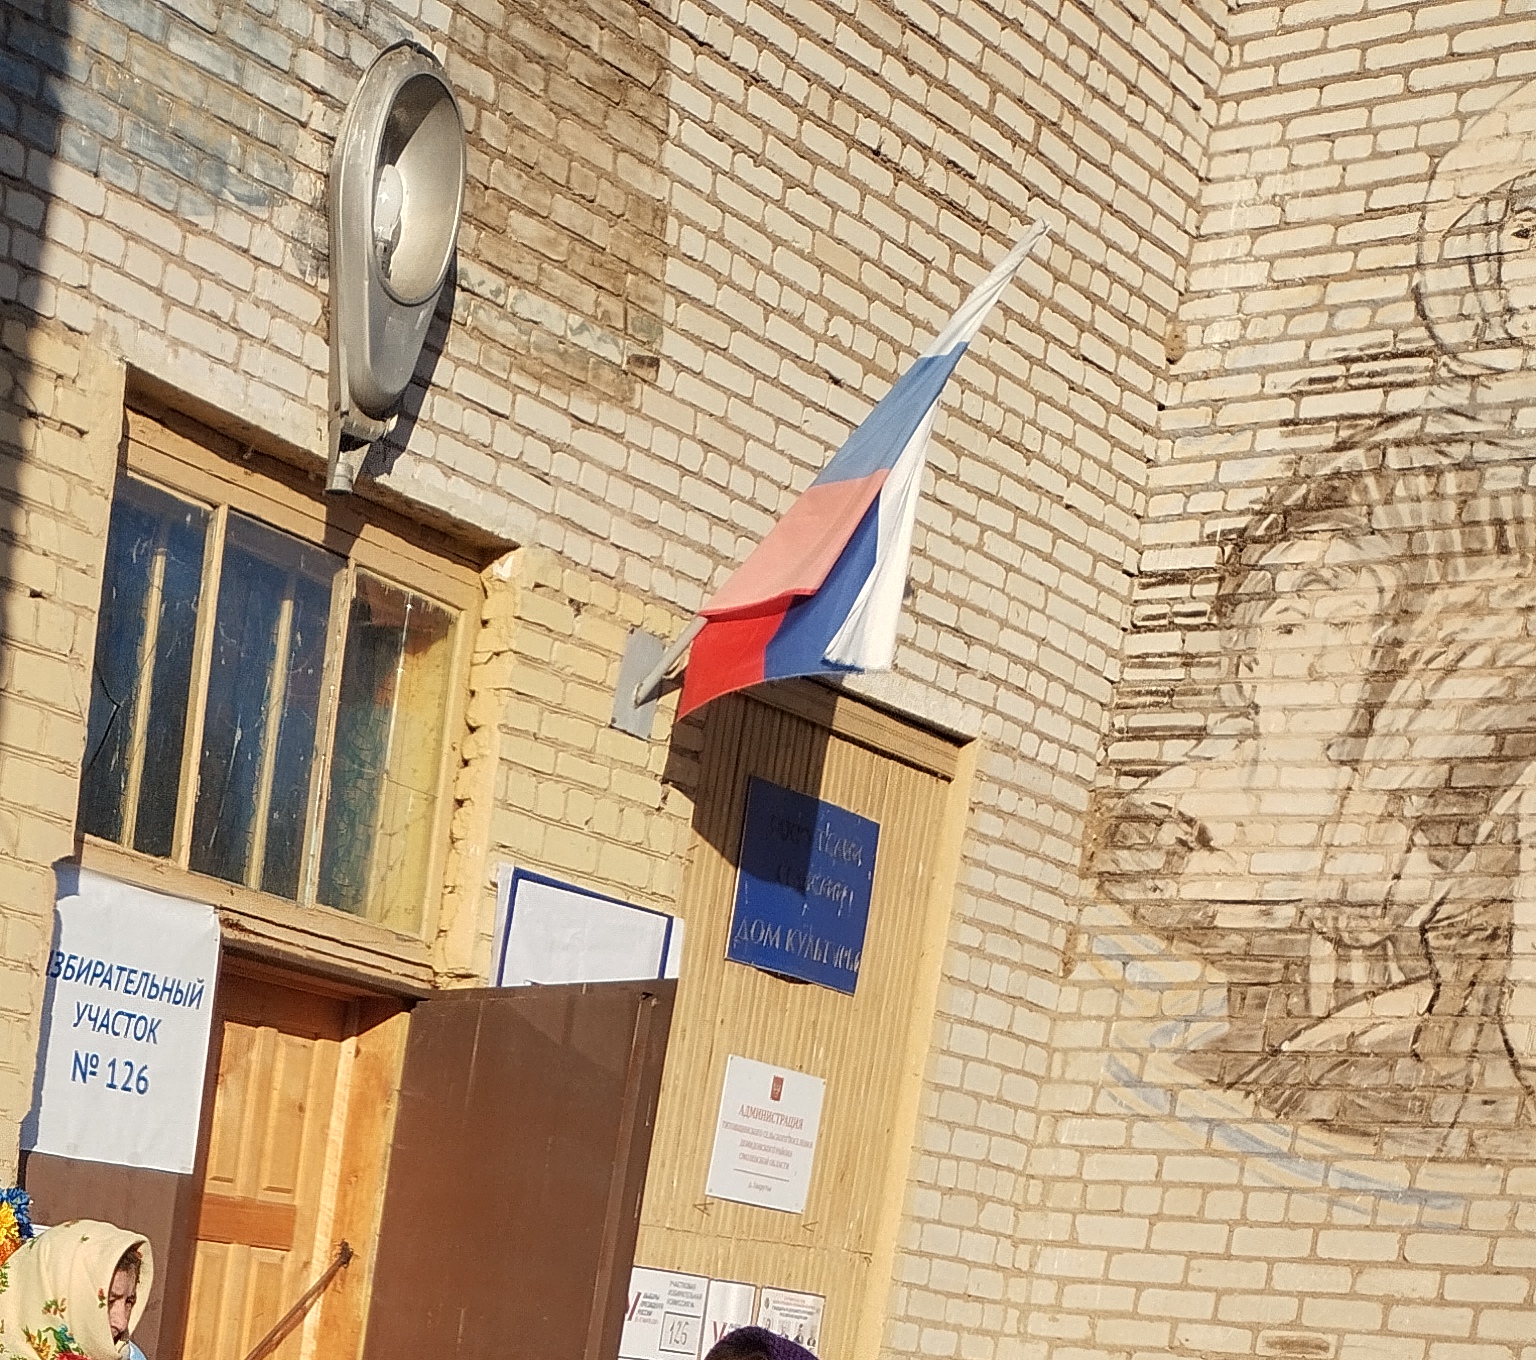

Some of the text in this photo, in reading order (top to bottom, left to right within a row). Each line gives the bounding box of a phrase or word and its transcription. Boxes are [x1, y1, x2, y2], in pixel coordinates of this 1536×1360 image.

[733, 915, 781, 951] ДОМ
[72, 1001, 163, 1045] УЧАСТОК
[71, 1050, 149, 1095] № 126
[738, 1104, 805, 1131] АДМИНИСТРАЦИЯ
